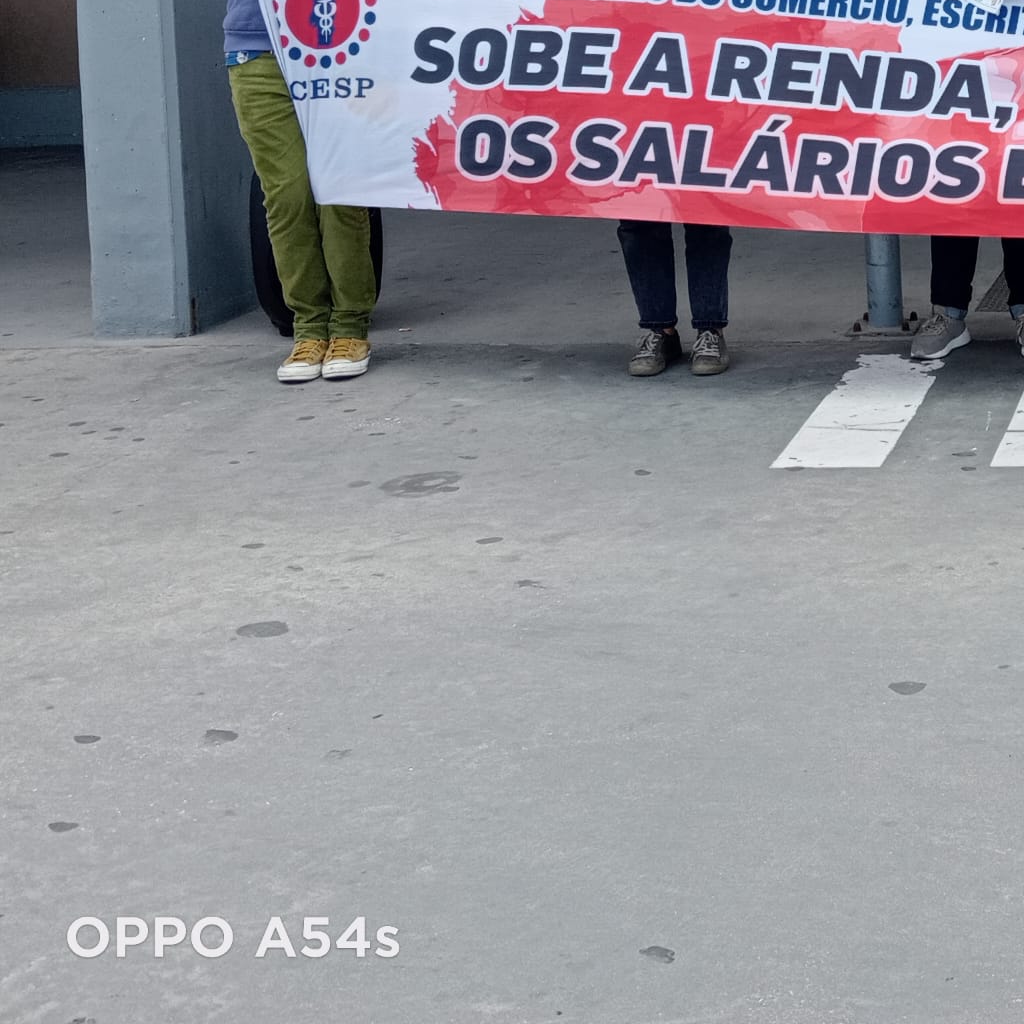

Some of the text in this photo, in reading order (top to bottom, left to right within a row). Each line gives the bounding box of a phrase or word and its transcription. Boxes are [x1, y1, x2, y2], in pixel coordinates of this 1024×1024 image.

[289, 77, 375, 102] CESP
[410, 27, 614, 89] SOBE
[628, 37, 688, 95] A
[710, 43, 1013, 129] RENDA,
[459, 119, 559, 179] OS
[569, 119, 985, 200] SALÁRIOS
